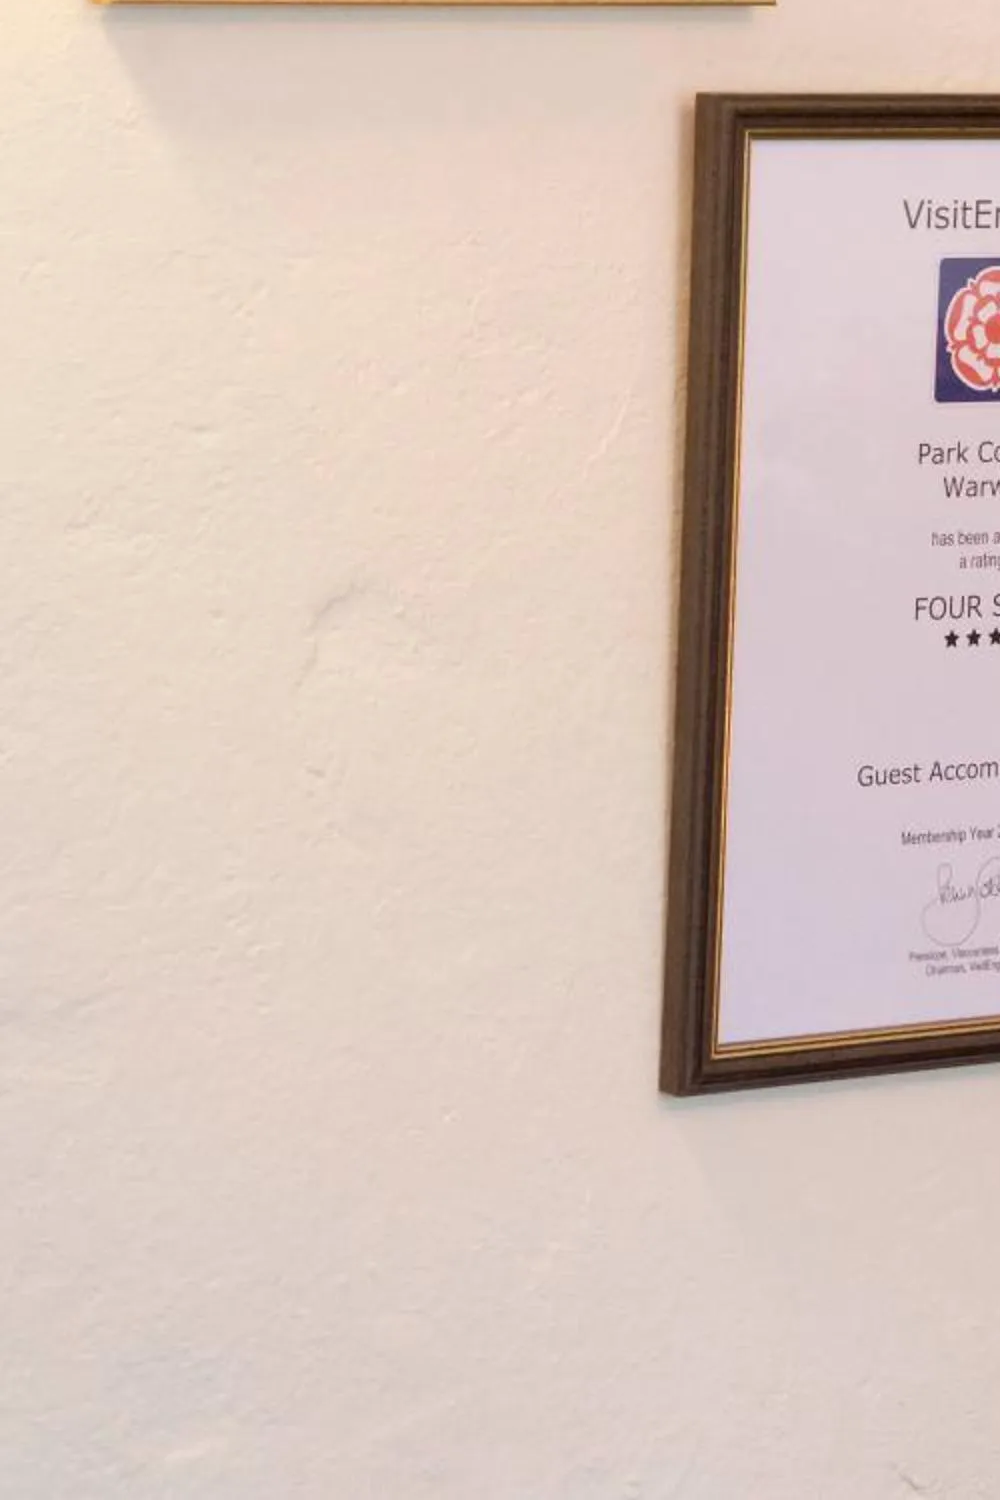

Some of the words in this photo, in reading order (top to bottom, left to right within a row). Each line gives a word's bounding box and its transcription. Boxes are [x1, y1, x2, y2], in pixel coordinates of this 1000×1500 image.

[918, 441, 969, 465] Park
[931, 531, 955, 547] has
[957, 529, 989, 546] been
[959, 555, 967, 569] a
[915, 595, 982, 621] FOUR
[857, 763, 922, 787] Guest
[901, 827, 967, 845] Membership
[969, 825, 994, 840] Year
